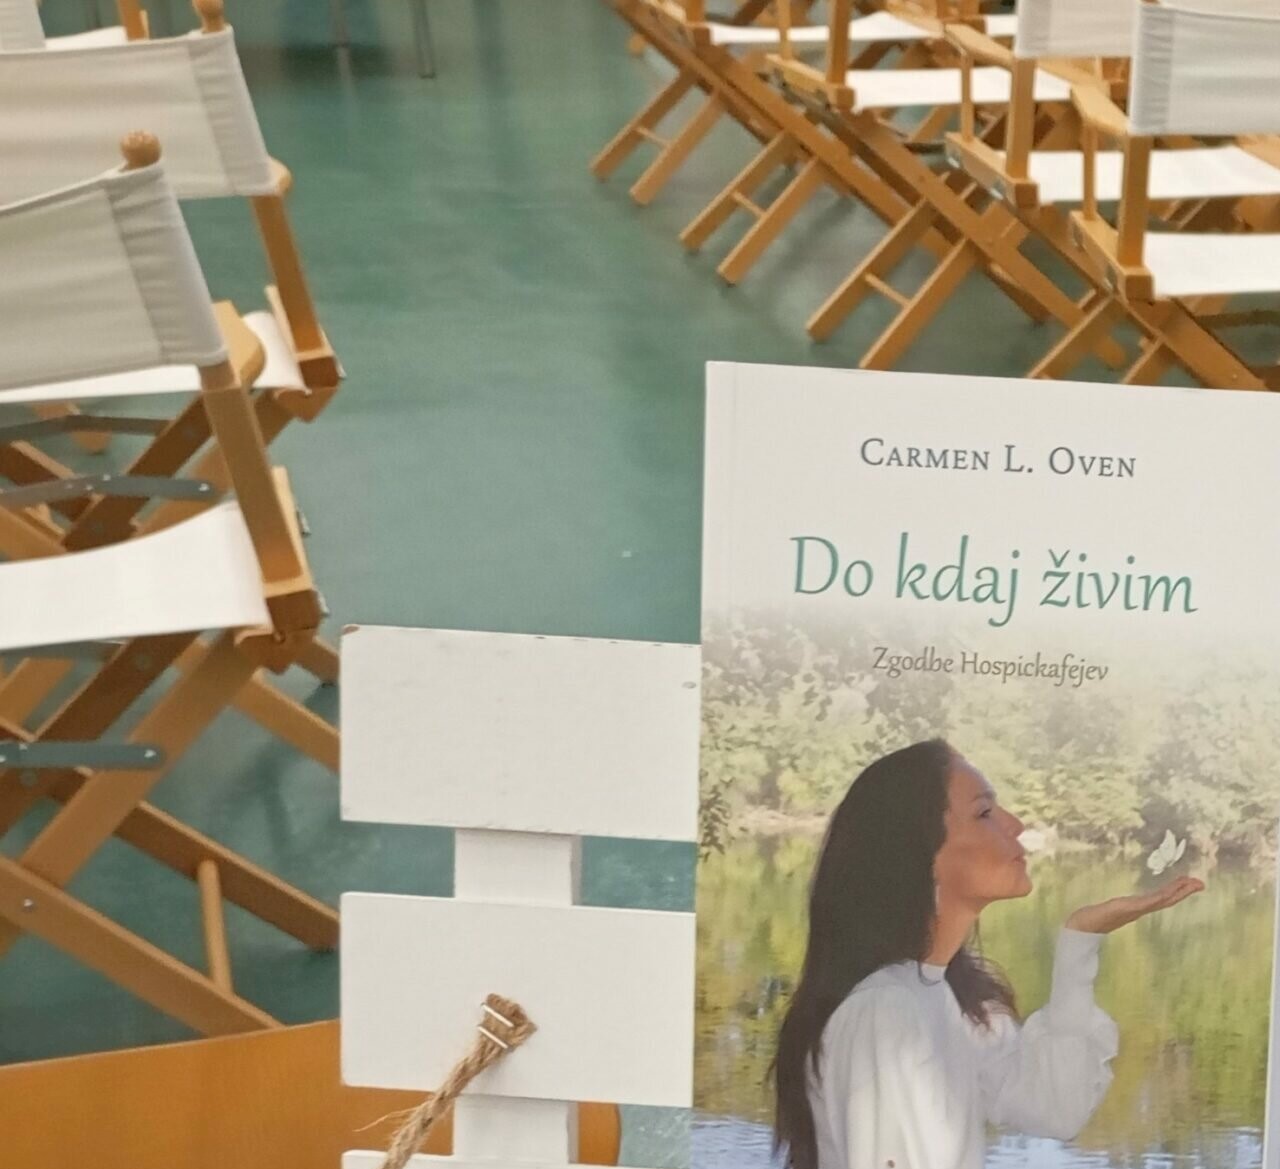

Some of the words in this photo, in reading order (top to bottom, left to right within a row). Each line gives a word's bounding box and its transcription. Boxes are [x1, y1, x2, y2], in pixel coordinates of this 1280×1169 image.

[1003, 444, 1034, 474] L.
[1048, 446, 1137, 478] OVEN
[789, 535, 874, 598] Do
[895, 531, 1021, 628] kdaj
[1039, 548, 1199, 614] živim
[872, 646, 955, 679] Zgodbe
[960, 651, 1109, 688] Hospickafejev
